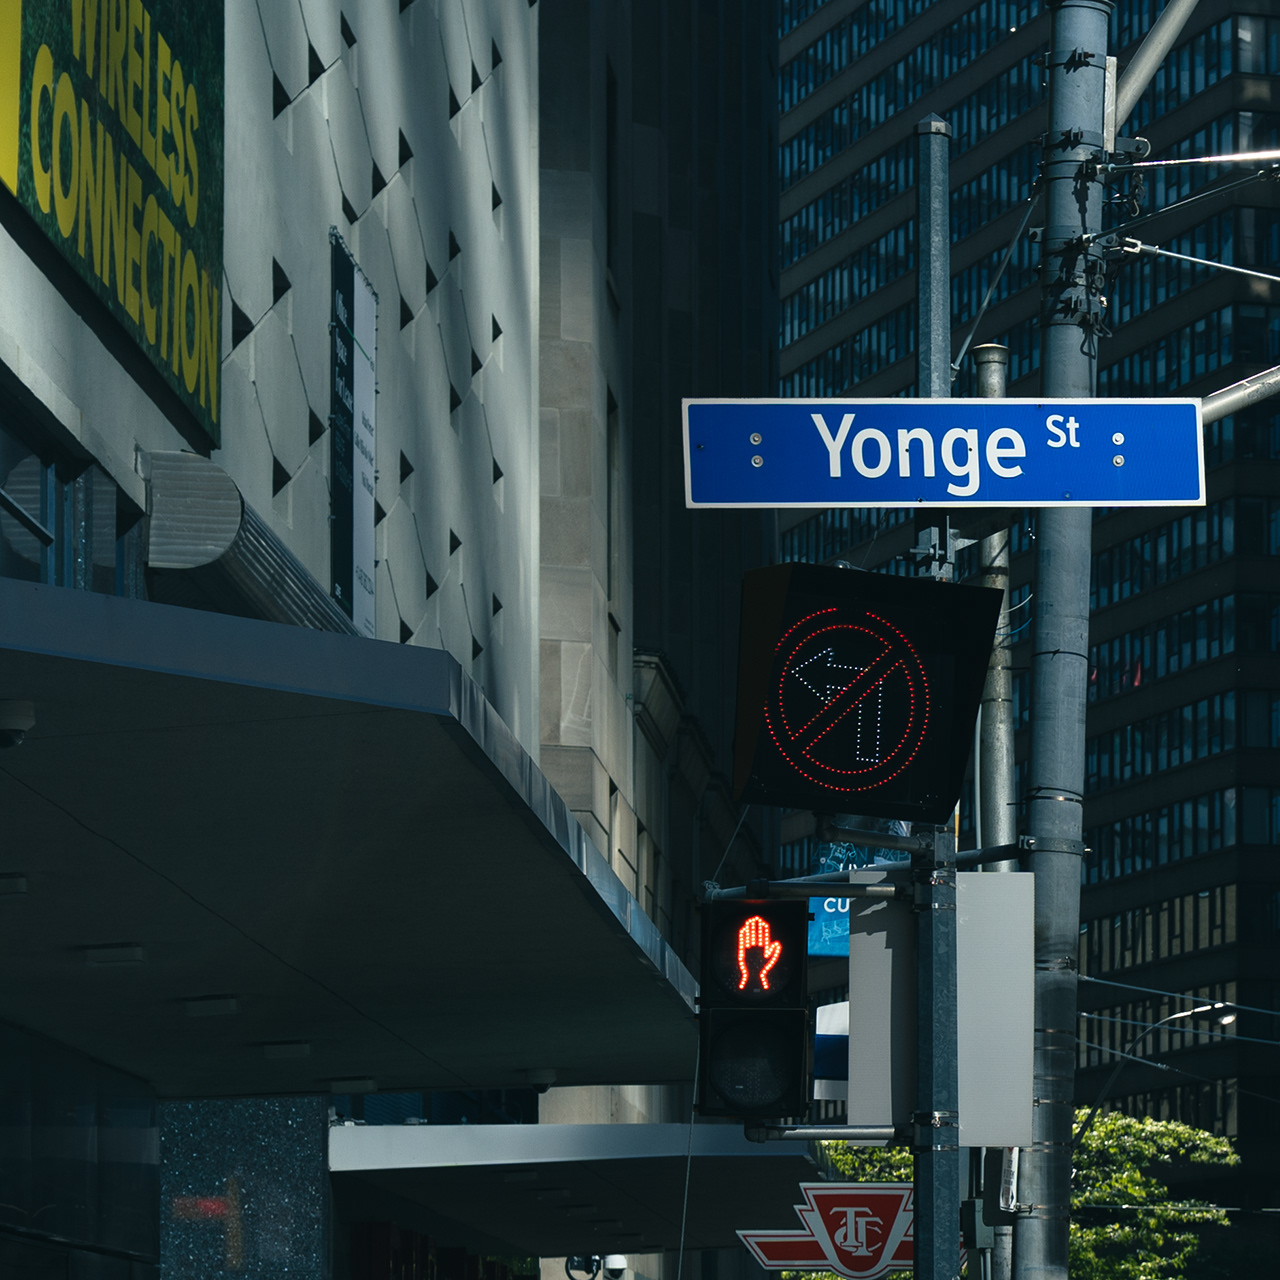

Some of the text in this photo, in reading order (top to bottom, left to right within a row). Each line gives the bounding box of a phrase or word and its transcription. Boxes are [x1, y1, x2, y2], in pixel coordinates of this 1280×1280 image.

[31, 43, 218, 424] CONNECTION
[810, 412, 1081, 498] Yonge St
[829, 1206, 884, 1257] TTC
